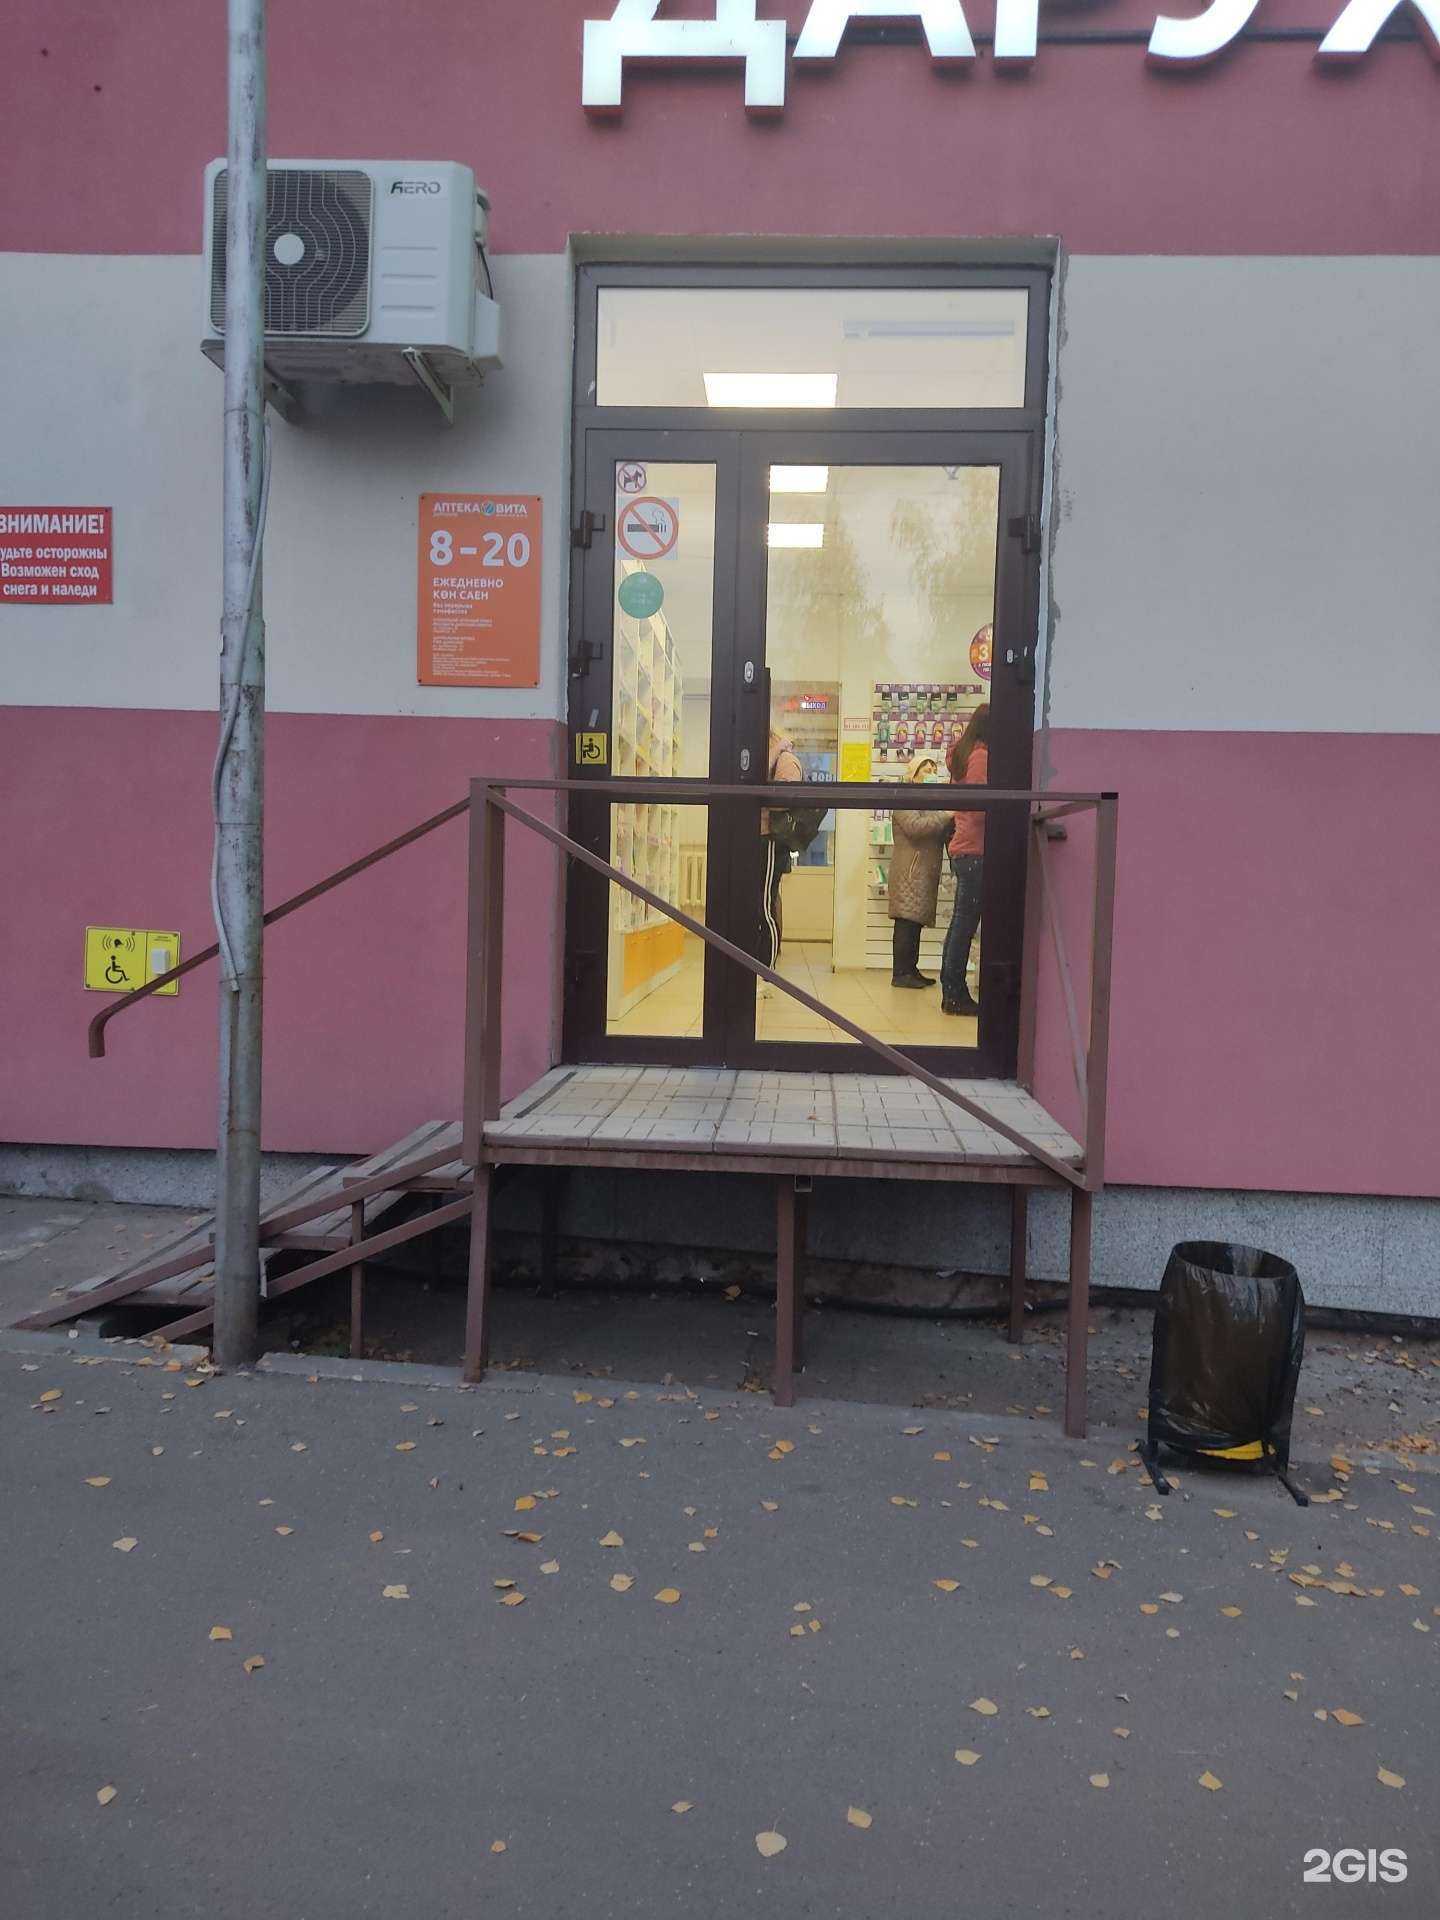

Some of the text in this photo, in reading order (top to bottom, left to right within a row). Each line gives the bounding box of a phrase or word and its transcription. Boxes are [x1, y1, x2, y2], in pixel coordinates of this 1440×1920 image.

[390, 181, 441, 194] AERO
[433, 502, 527, 514] АПТЕКА ВИТА
[0, 547, 107, 561] удьте осторожны
[1, 563, 99, 579] Возможен сход
[433, 577, 504, 589] ЕЖЕДНЕВНО
[3, 584, 97, 597] снега и наледи
[459, 590, 489, 600] САЕН
